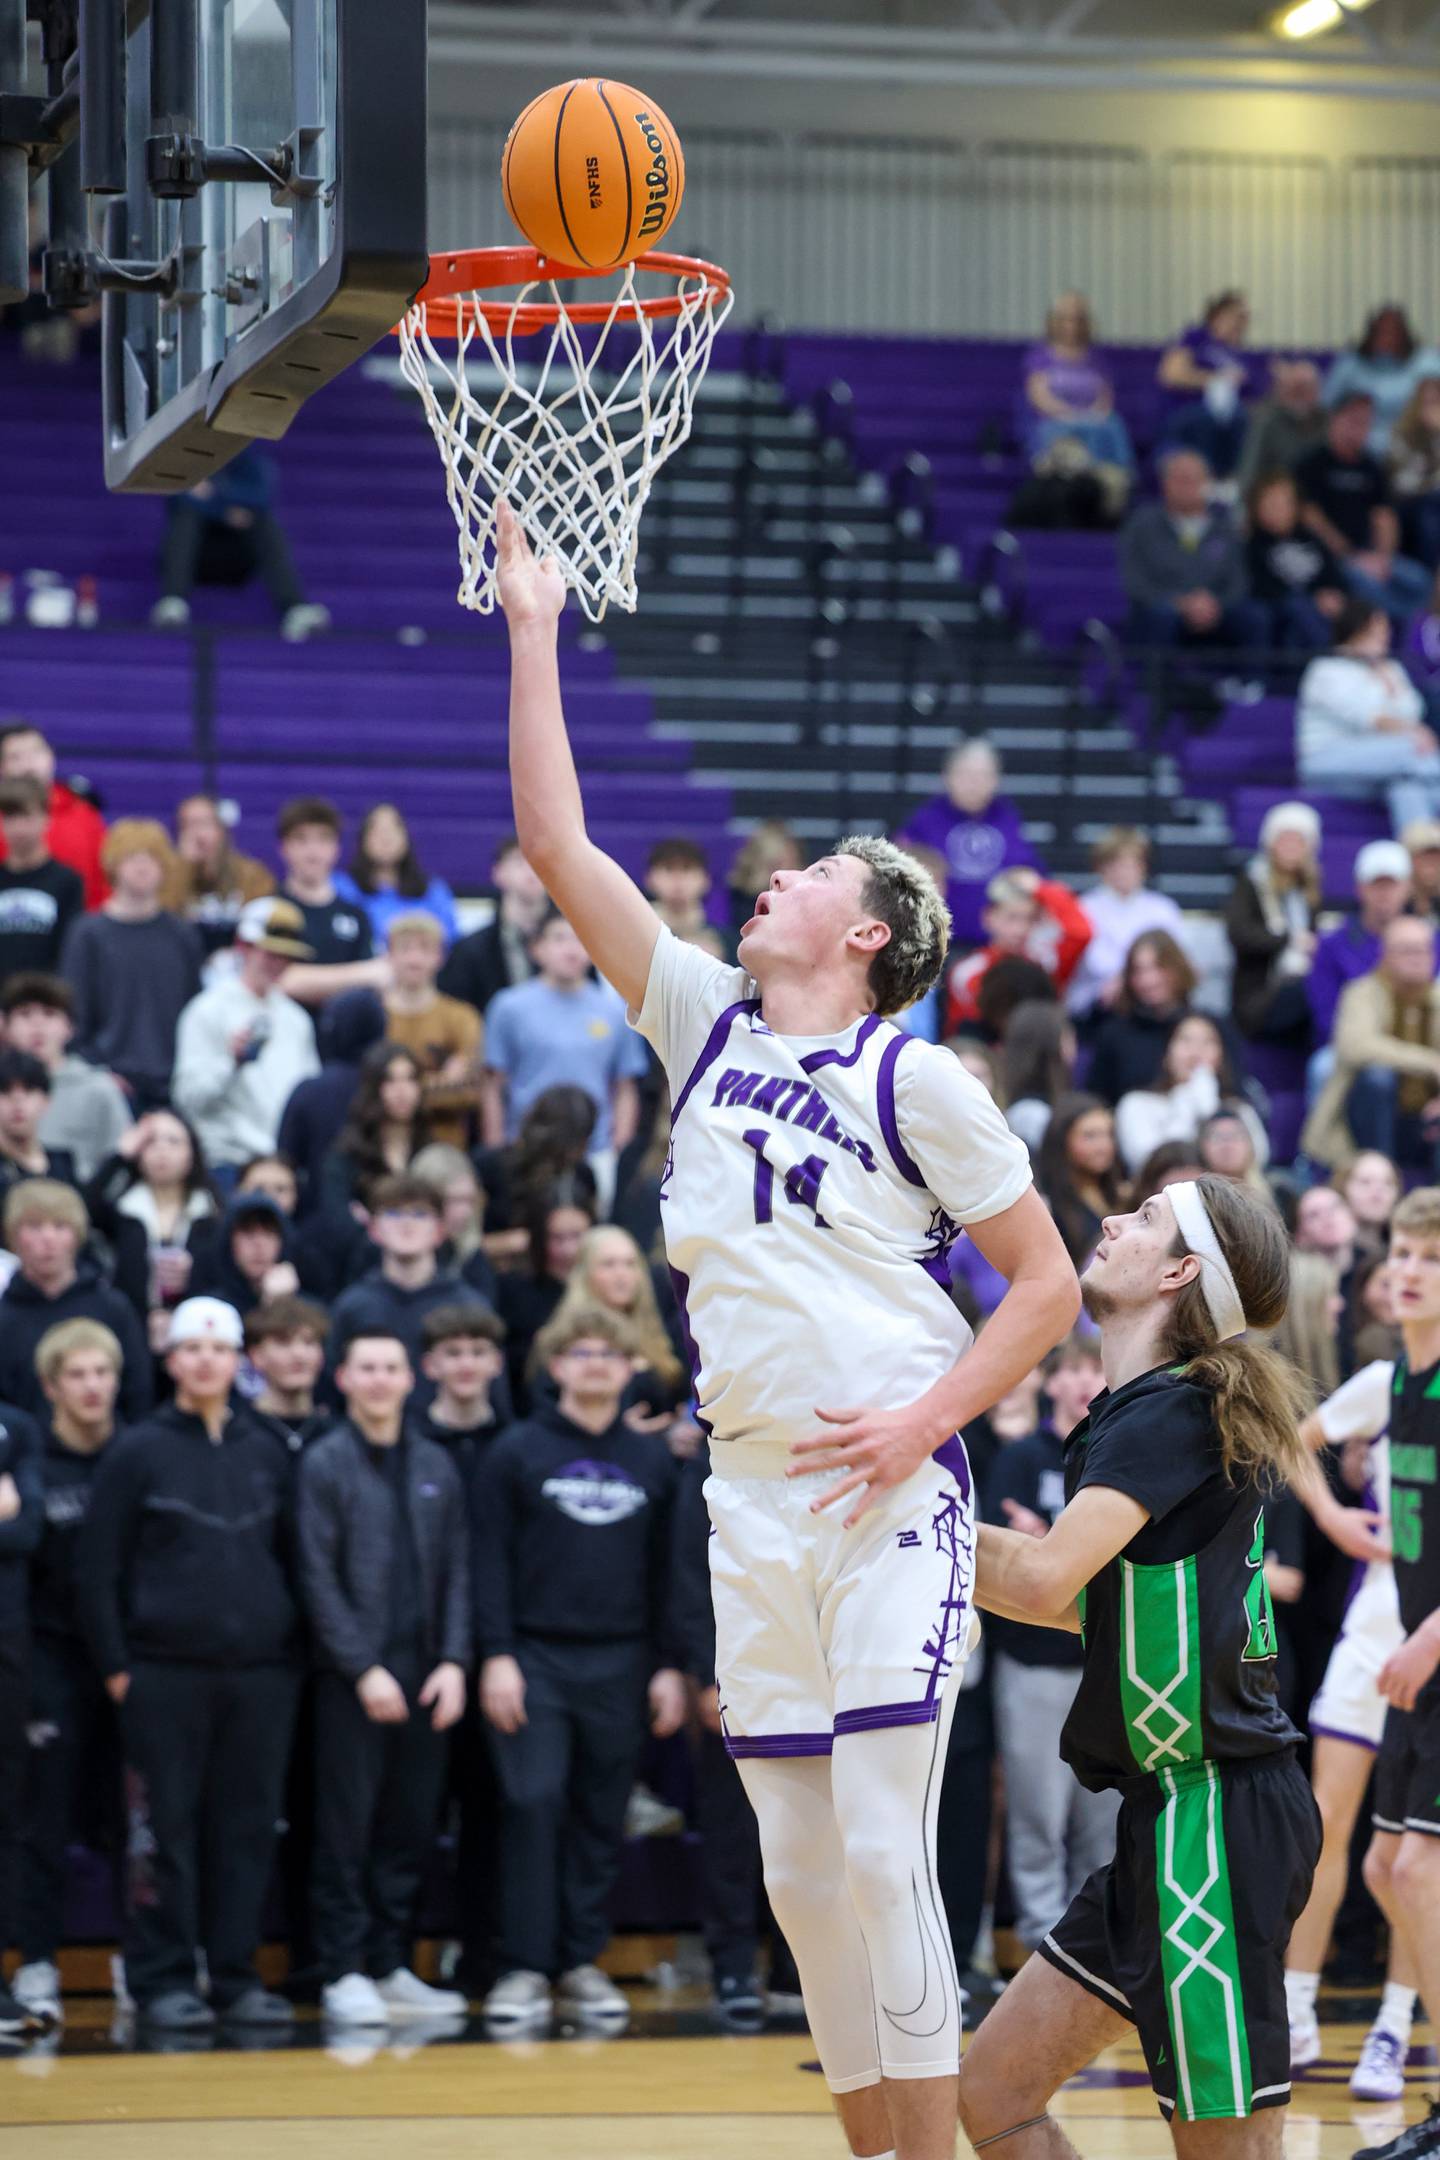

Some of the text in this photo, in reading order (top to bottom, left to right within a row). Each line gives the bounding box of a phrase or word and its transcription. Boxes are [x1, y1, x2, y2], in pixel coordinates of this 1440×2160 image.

[586, 156, 602, 197] NFHS
[634, 111, 669, 238] Wilson
[742, 1128, 834, 1230] 14
